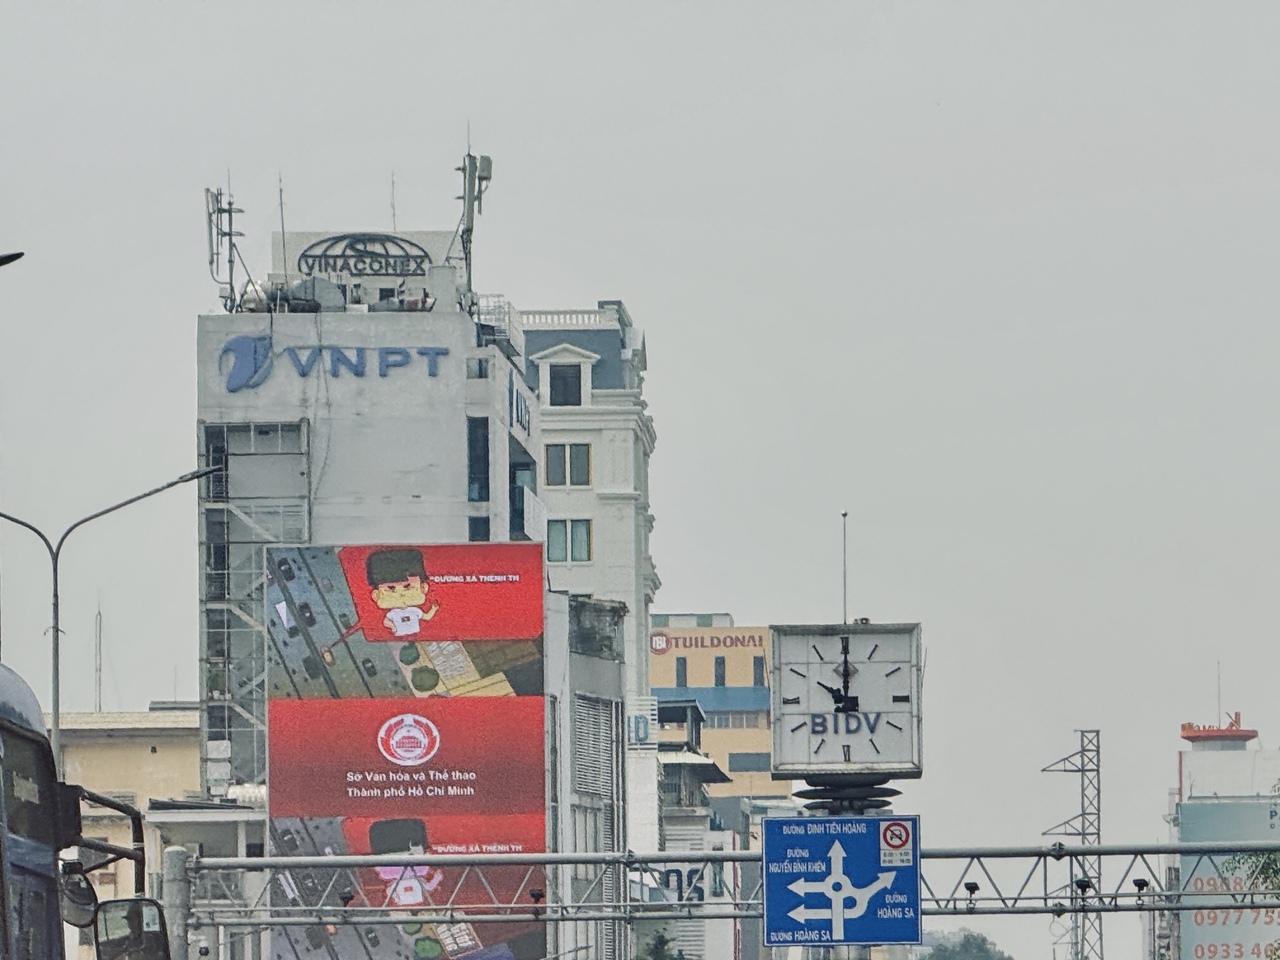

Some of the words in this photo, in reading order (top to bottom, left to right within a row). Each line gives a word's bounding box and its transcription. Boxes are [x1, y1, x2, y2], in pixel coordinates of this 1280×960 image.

[305, 258, 426, 275] VINACONEX
[286, 347, 449, 378] VNPT
[811, 713, 881, 735] BIDV
[451, 770, 476, 781] thao
[447, 785, 475, 796] Minh
[783, 824, 805, 835] ĐƯỜNG
[842, 821, 867, 834] HOÀNG
[877, 905, 903, 919] HOÀNG
[904, 908, 915, 919] SA
[1193, 909, 1244, 926] 0977
[794, 928, 820, 941] HOÀNG
[821, 931, 831, 941] SA
[1194, 943, 1244, 960] 0933
